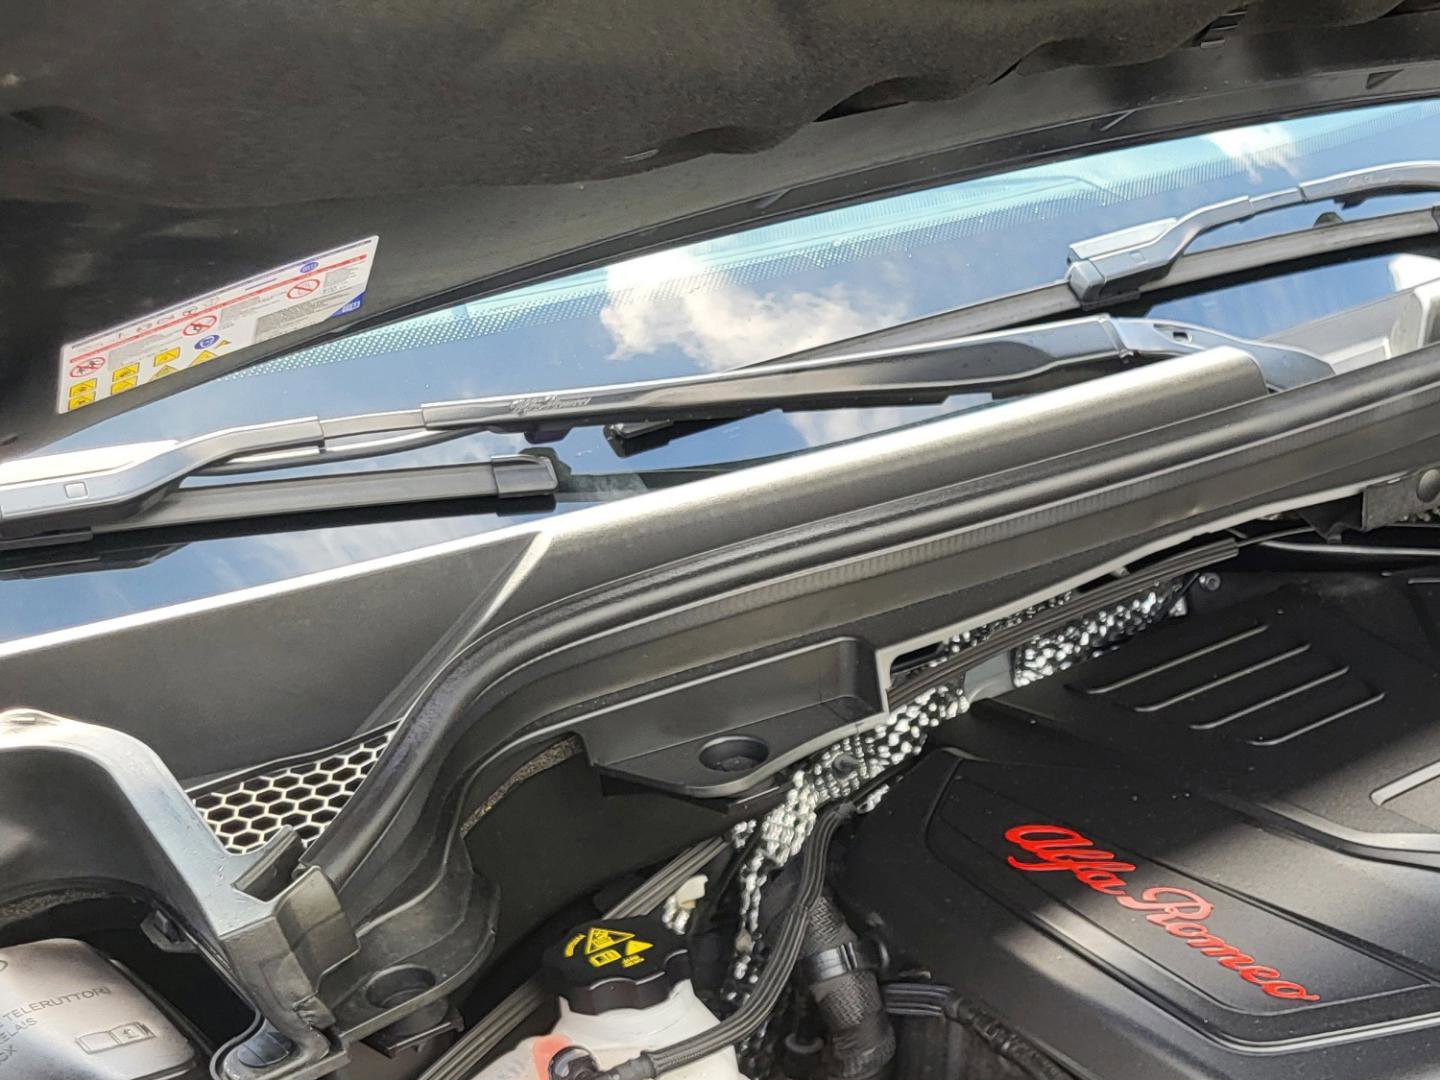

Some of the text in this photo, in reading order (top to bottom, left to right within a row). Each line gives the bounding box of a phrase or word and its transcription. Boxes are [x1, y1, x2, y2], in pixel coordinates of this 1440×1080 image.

[1004, 824, 1321, 1001] Alfa Romeo
[3, 986, 111, 1021] TELERUTTORI
